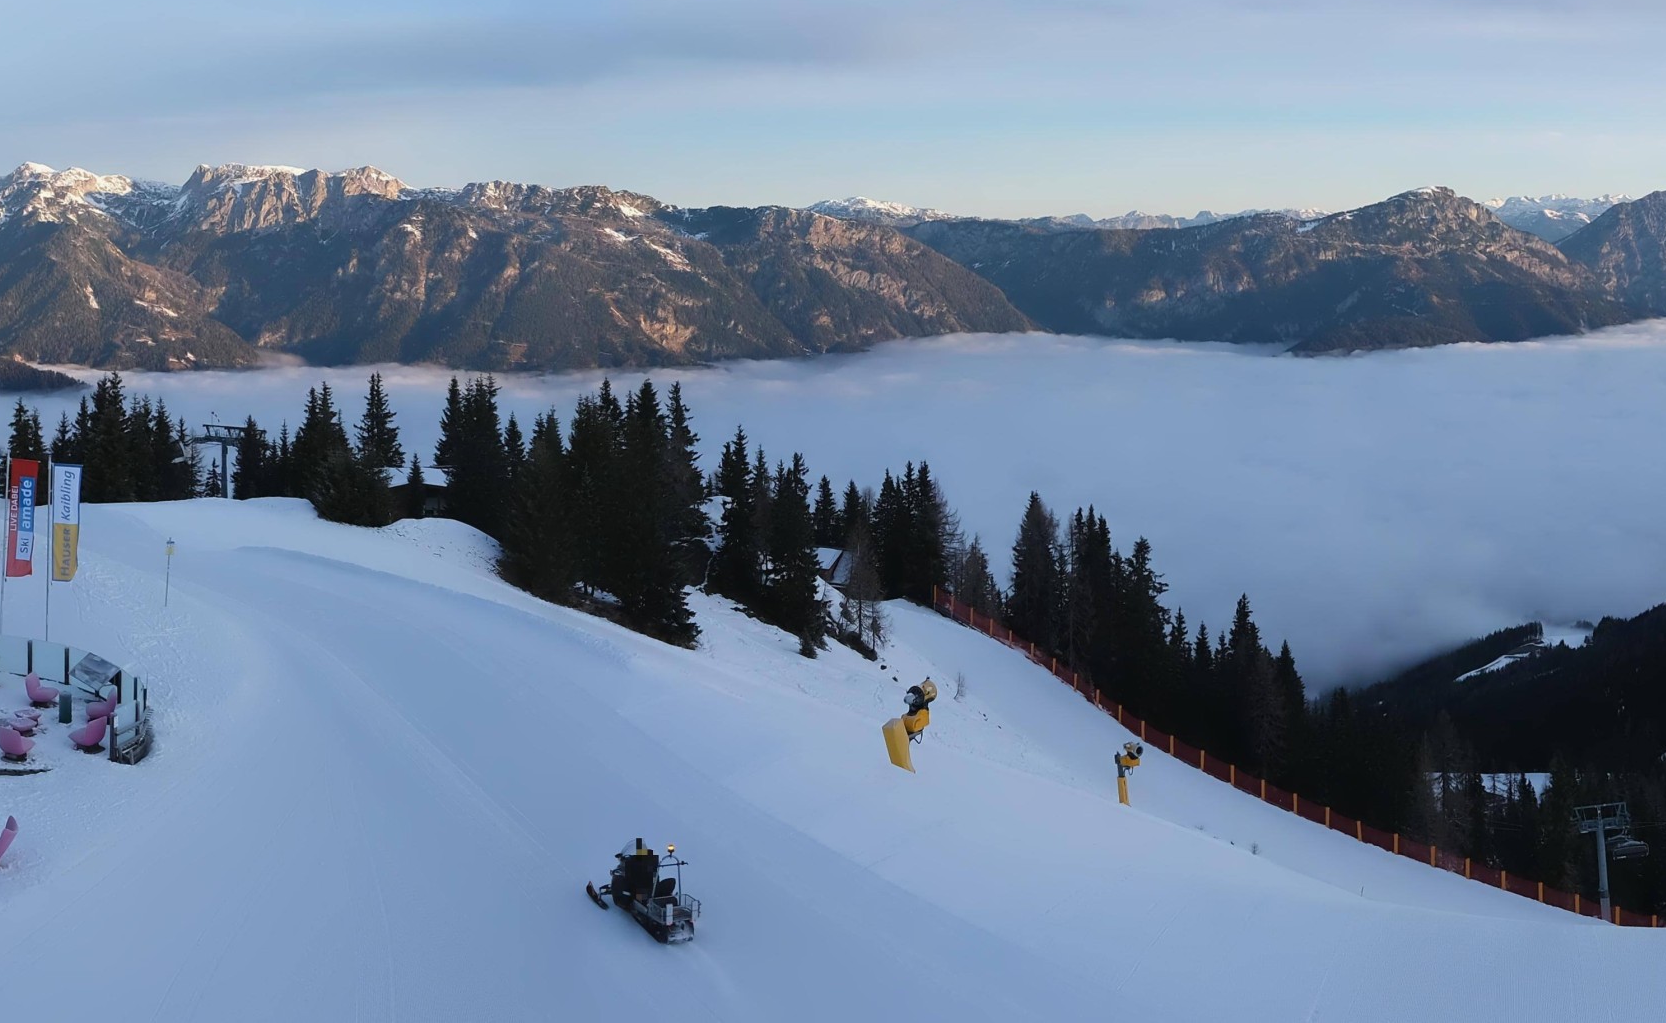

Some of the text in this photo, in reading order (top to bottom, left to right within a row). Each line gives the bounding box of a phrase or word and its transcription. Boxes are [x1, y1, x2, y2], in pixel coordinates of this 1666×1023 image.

[10, 485, 19, 531] LIVE DABEI
[20, 479, 32, 553] Ski amade
[61, 470, 75, 576] HAUSER Kaibling
